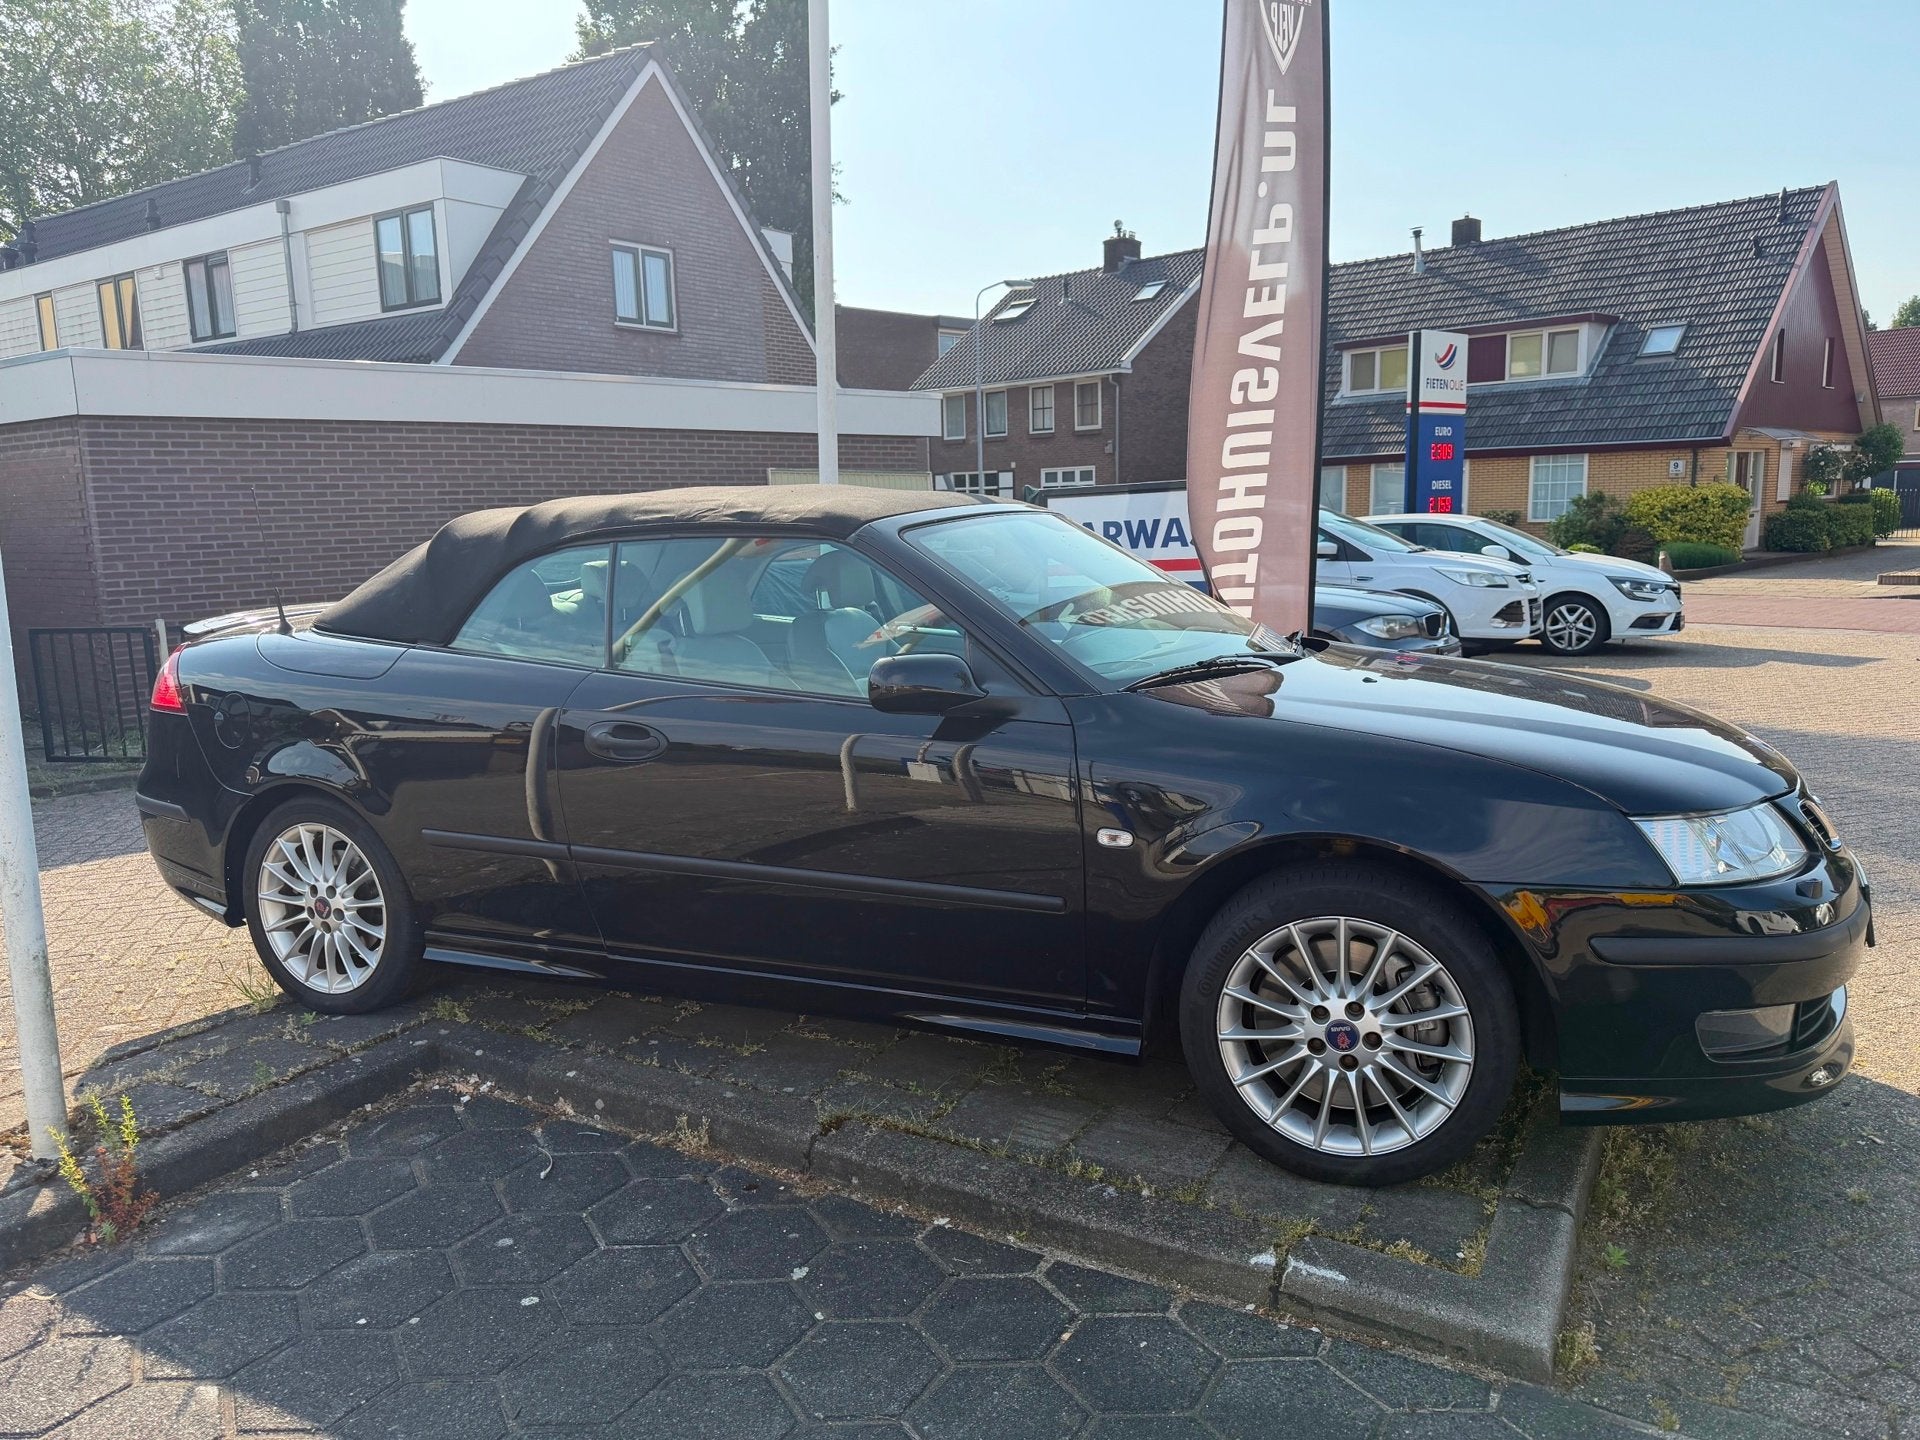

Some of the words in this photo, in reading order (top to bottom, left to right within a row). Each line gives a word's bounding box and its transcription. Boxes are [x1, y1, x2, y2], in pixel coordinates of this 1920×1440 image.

[1426, 378, 1448, 390] FIETEN
[1435, 426, 1452, 436] EURO
[1431, 480, 1452, 490] DIESEL
